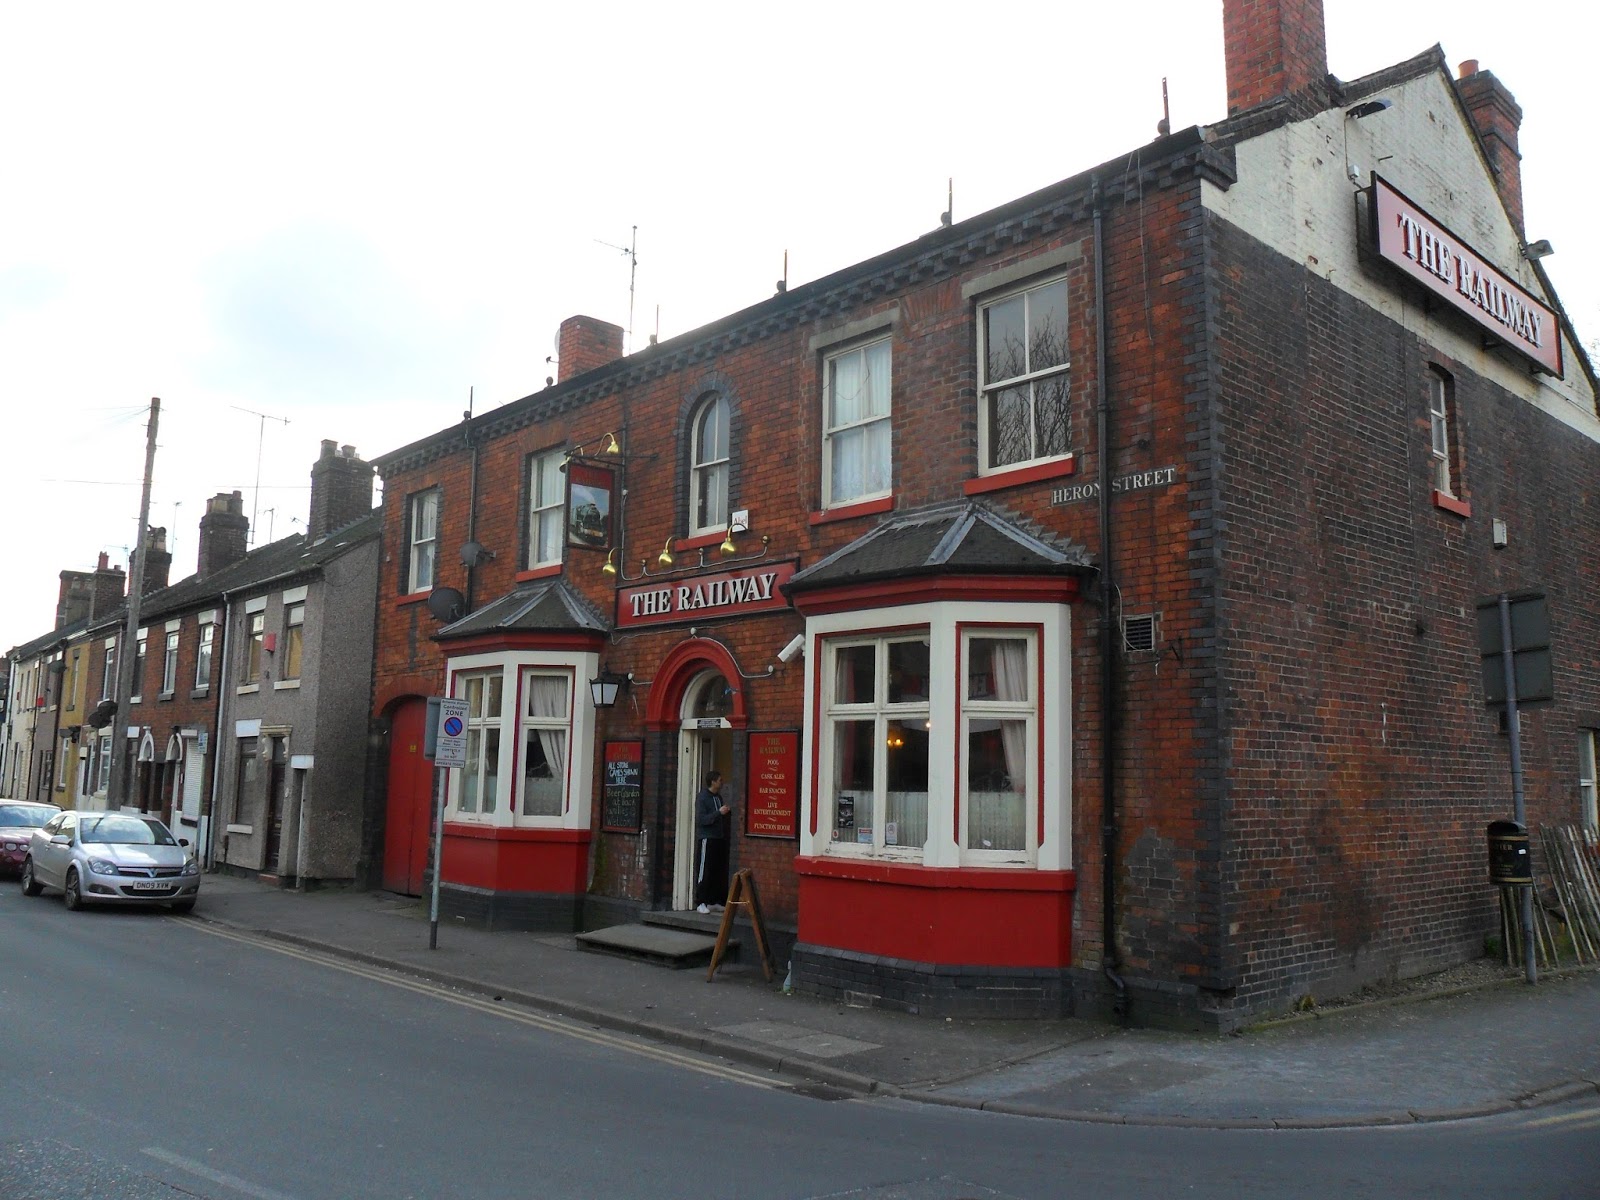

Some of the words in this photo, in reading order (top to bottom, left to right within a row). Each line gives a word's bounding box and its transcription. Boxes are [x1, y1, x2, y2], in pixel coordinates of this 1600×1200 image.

[1398, 212, 1453, 285] THE
[1454, 254, 1543, 348] RAILWAY
[1111, 468, 1175, 492] STREET
[630, 589, 672, 617] THE
[676, 573, 776, 611] RAILWAY
[607, 787, 621, 797] Beer
[754, 808, 791, 816] ENTERTAINMENT
[137, 881, 155, 889] DN09
